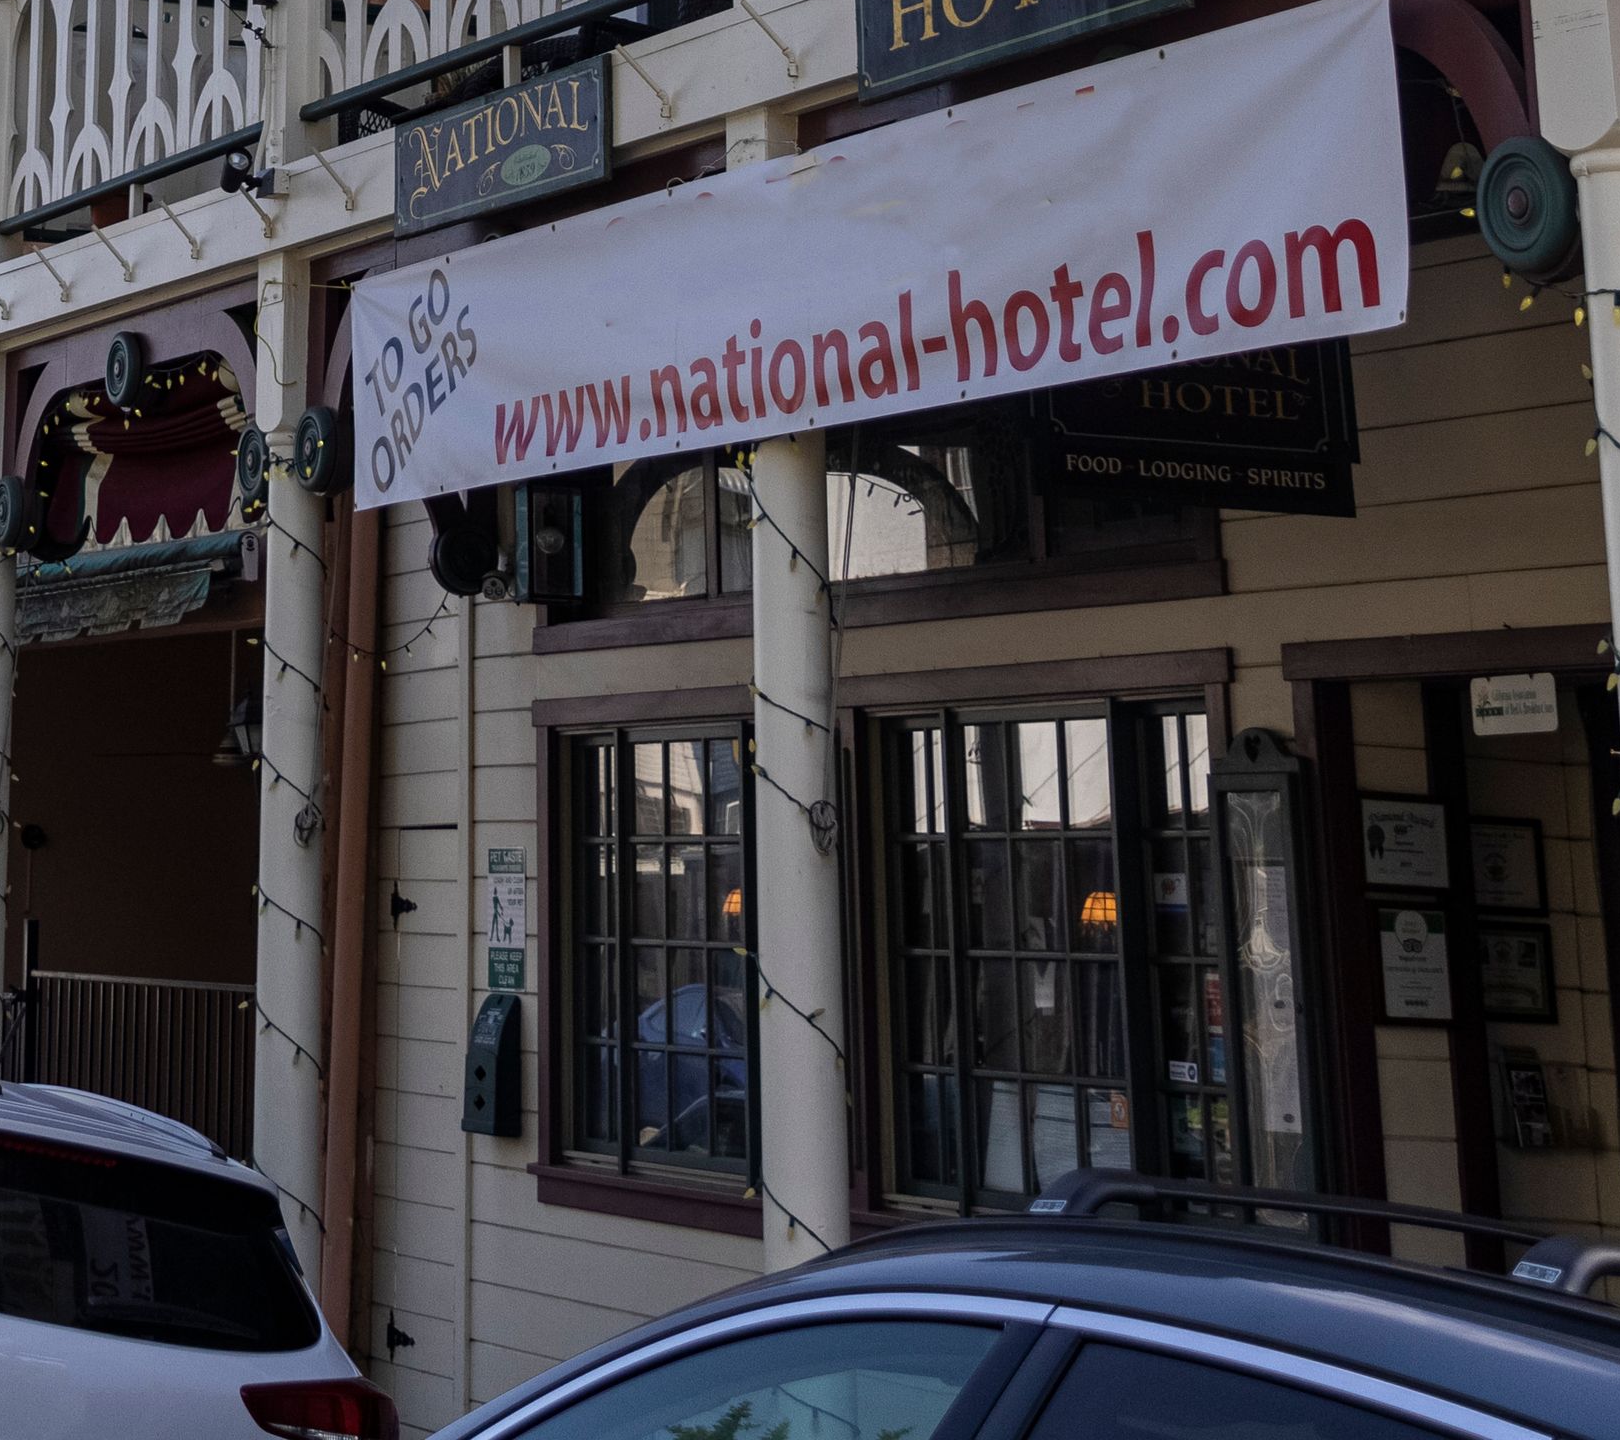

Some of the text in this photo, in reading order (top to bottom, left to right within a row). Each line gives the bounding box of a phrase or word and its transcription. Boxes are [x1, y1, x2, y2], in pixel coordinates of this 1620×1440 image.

[365, 269, 451, 417] TO GO
[493, 217, 1381, 466] www.national-hotel.com
[370, 304, 478, 493] ORDERS
[1139, 378, 1301, 420] HOTEL
[1065, 454, 1326, 489] FOOD LODGING SPIRITS
[490, 851, 523, 863] PET WASTE
